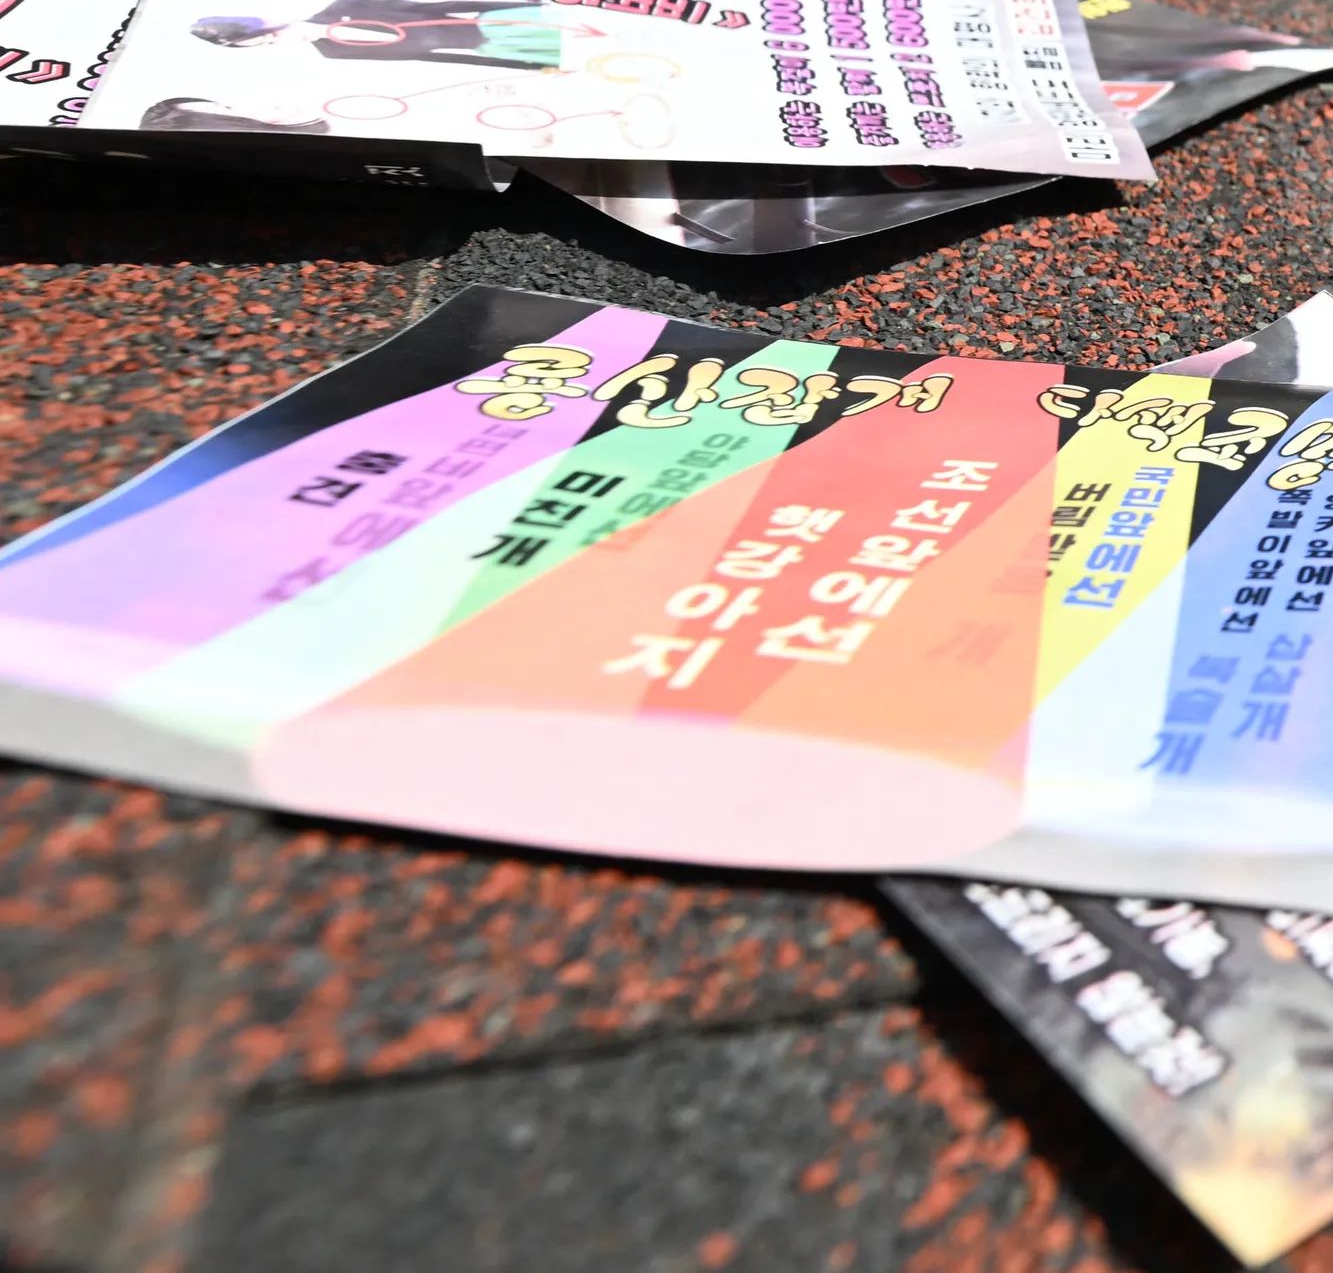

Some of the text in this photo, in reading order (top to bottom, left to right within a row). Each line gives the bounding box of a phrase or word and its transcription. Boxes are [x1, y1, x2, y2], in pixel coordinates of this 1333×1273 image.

[287, 450, 409, 509] 충견
[469, 471, 624, 567] 미친개
[1061, 466, 1176, 609] 국민앞에선
[604, 456, 998, 690] 조선앞에선 햇강아지
